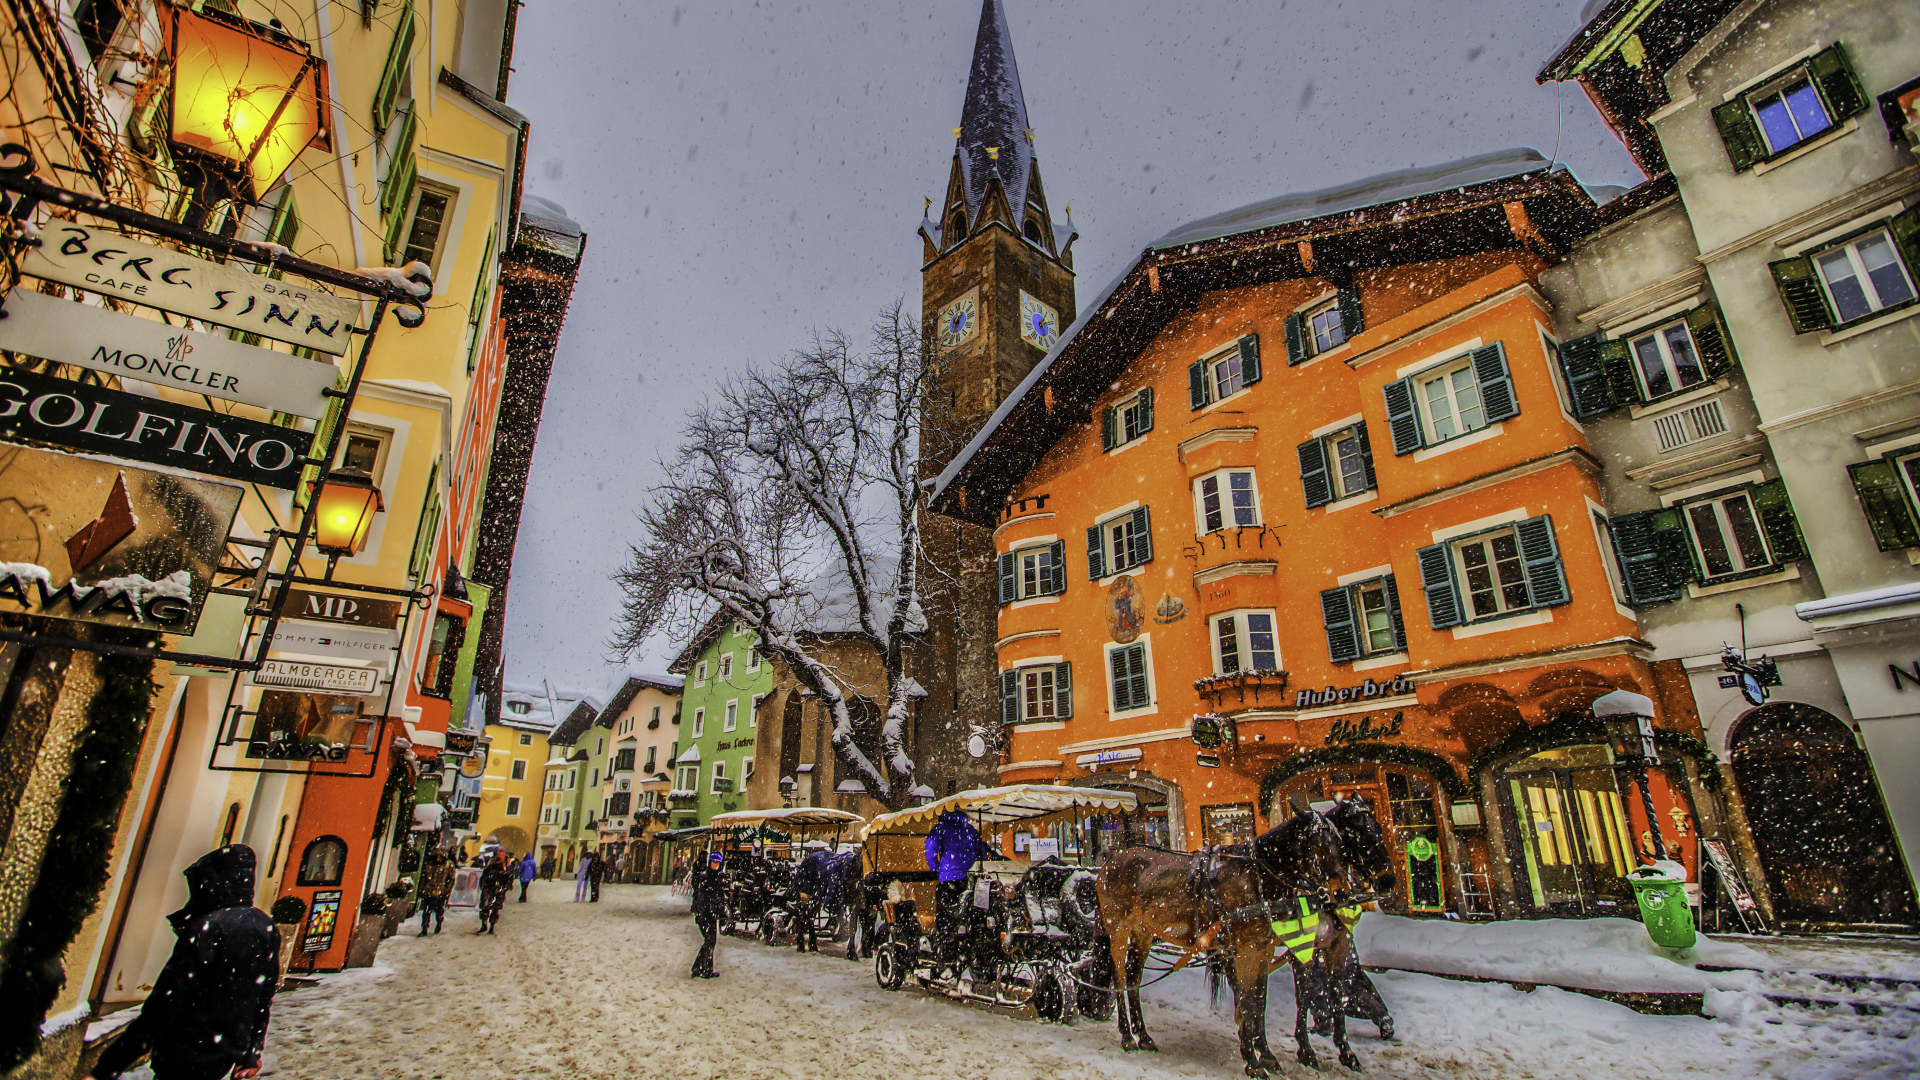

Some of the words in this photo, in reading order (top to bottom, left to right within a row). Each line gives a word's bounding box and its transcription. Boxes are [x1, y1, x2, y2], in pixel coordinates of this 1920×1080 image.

[61, 227, 192, 289] BERG
[209, 291, 340, 338] SINN
[85, 273, 148, 296] CAFÉ
[263, 283, 307, 302] BAR
[91, 345, 240, 394] MONCLER
[0, 381, 294, 471] GOLFINO
[273, 632, 316, 645] OMMY
[333, 639, 386, 652] HILFIGER
[266, 662, 369, 682] ALMBERGER
[250, 742, 345, 761] BAWAG
